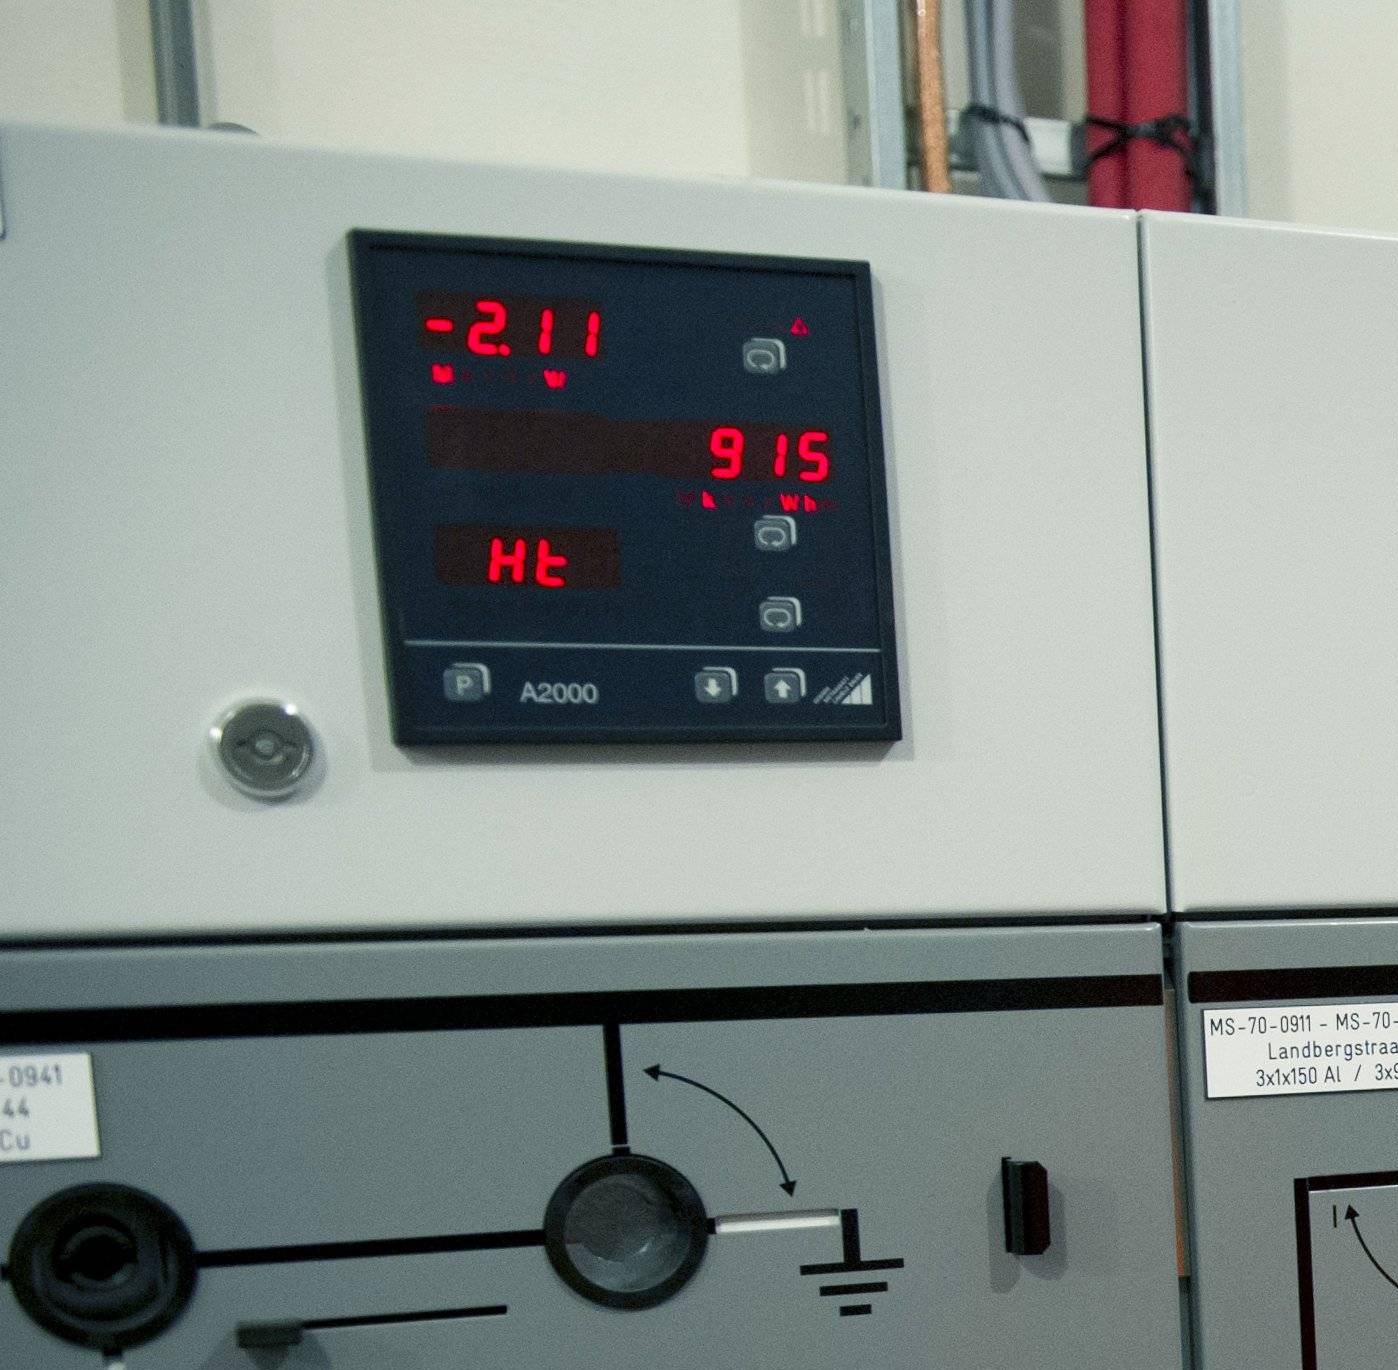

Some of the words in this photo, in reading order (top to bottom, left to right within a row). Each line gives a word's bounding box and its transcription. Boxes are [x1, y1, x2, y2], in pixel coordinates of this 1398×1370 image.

[709, 426, 830, 482] 915
[456, 674, 473, 696] P
[519, 681, 600, 704] A2000
[1210, 1014, 1312, 1036] MS-70-0911
[1255, 1066, 1317, 1087] 3x1x150
[1324, 1065, 1341, 1083] Al
[1353, 1064, 1362, 1082] /
